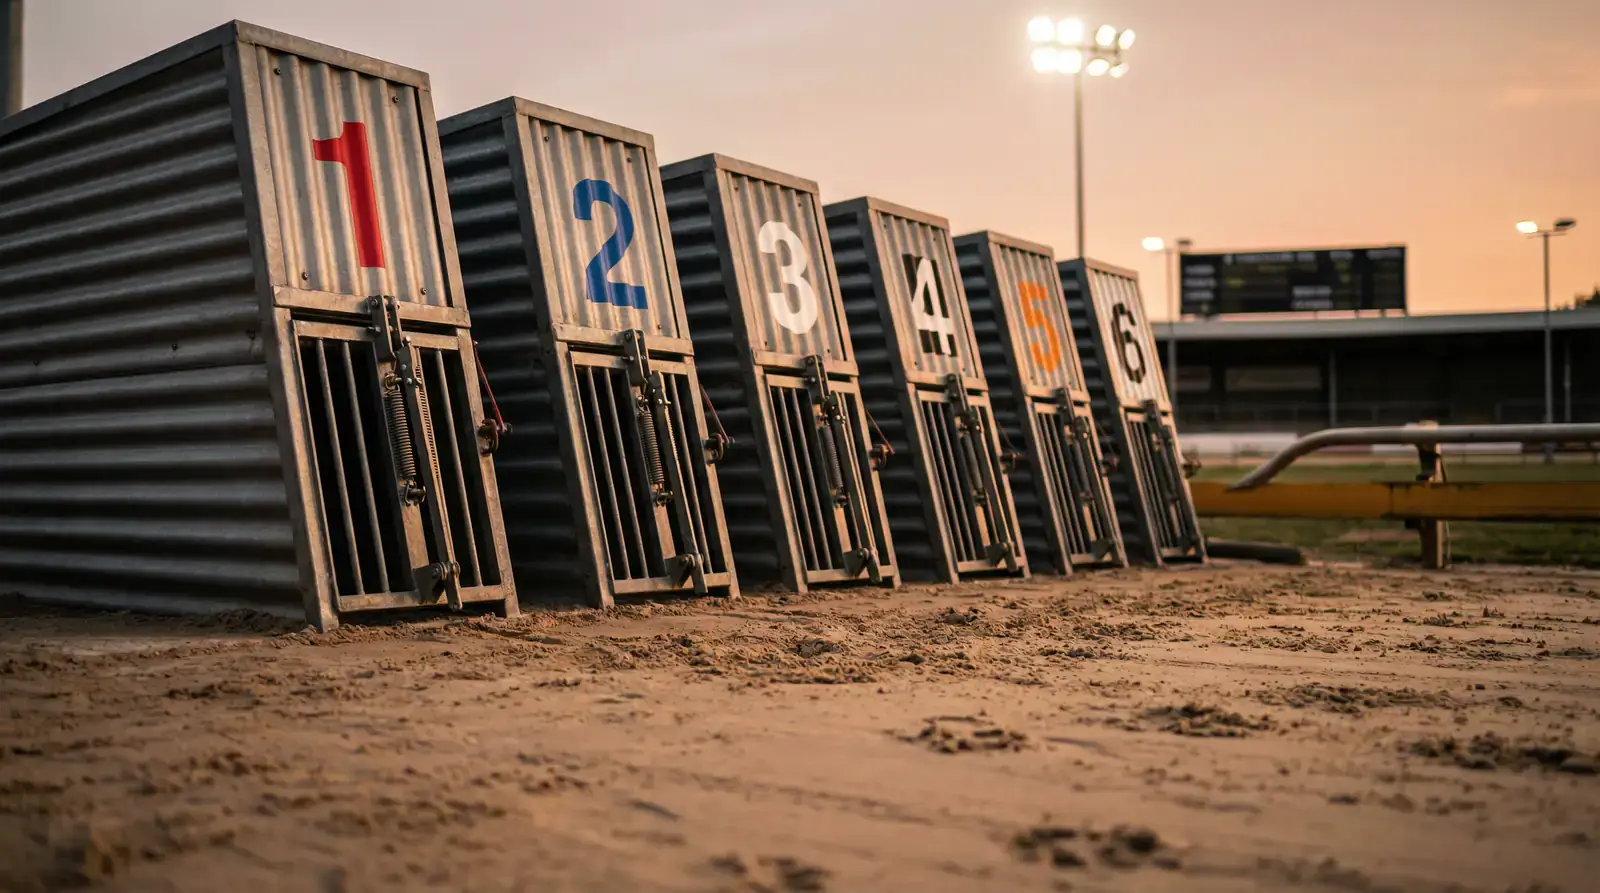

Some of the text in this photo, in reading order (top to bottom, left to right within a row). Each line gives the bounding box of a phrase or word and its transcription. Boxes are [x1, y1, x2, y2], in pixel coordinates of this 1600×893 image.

[312, 121, 385, 268] 1
[573, 178, 648, 309] 2
[758, 220, 818, 335] 3
[910, 255, 954, 357] 4
[1017, 280, 1061, 373] 5
[1111, 302, 1147, 384] 6
